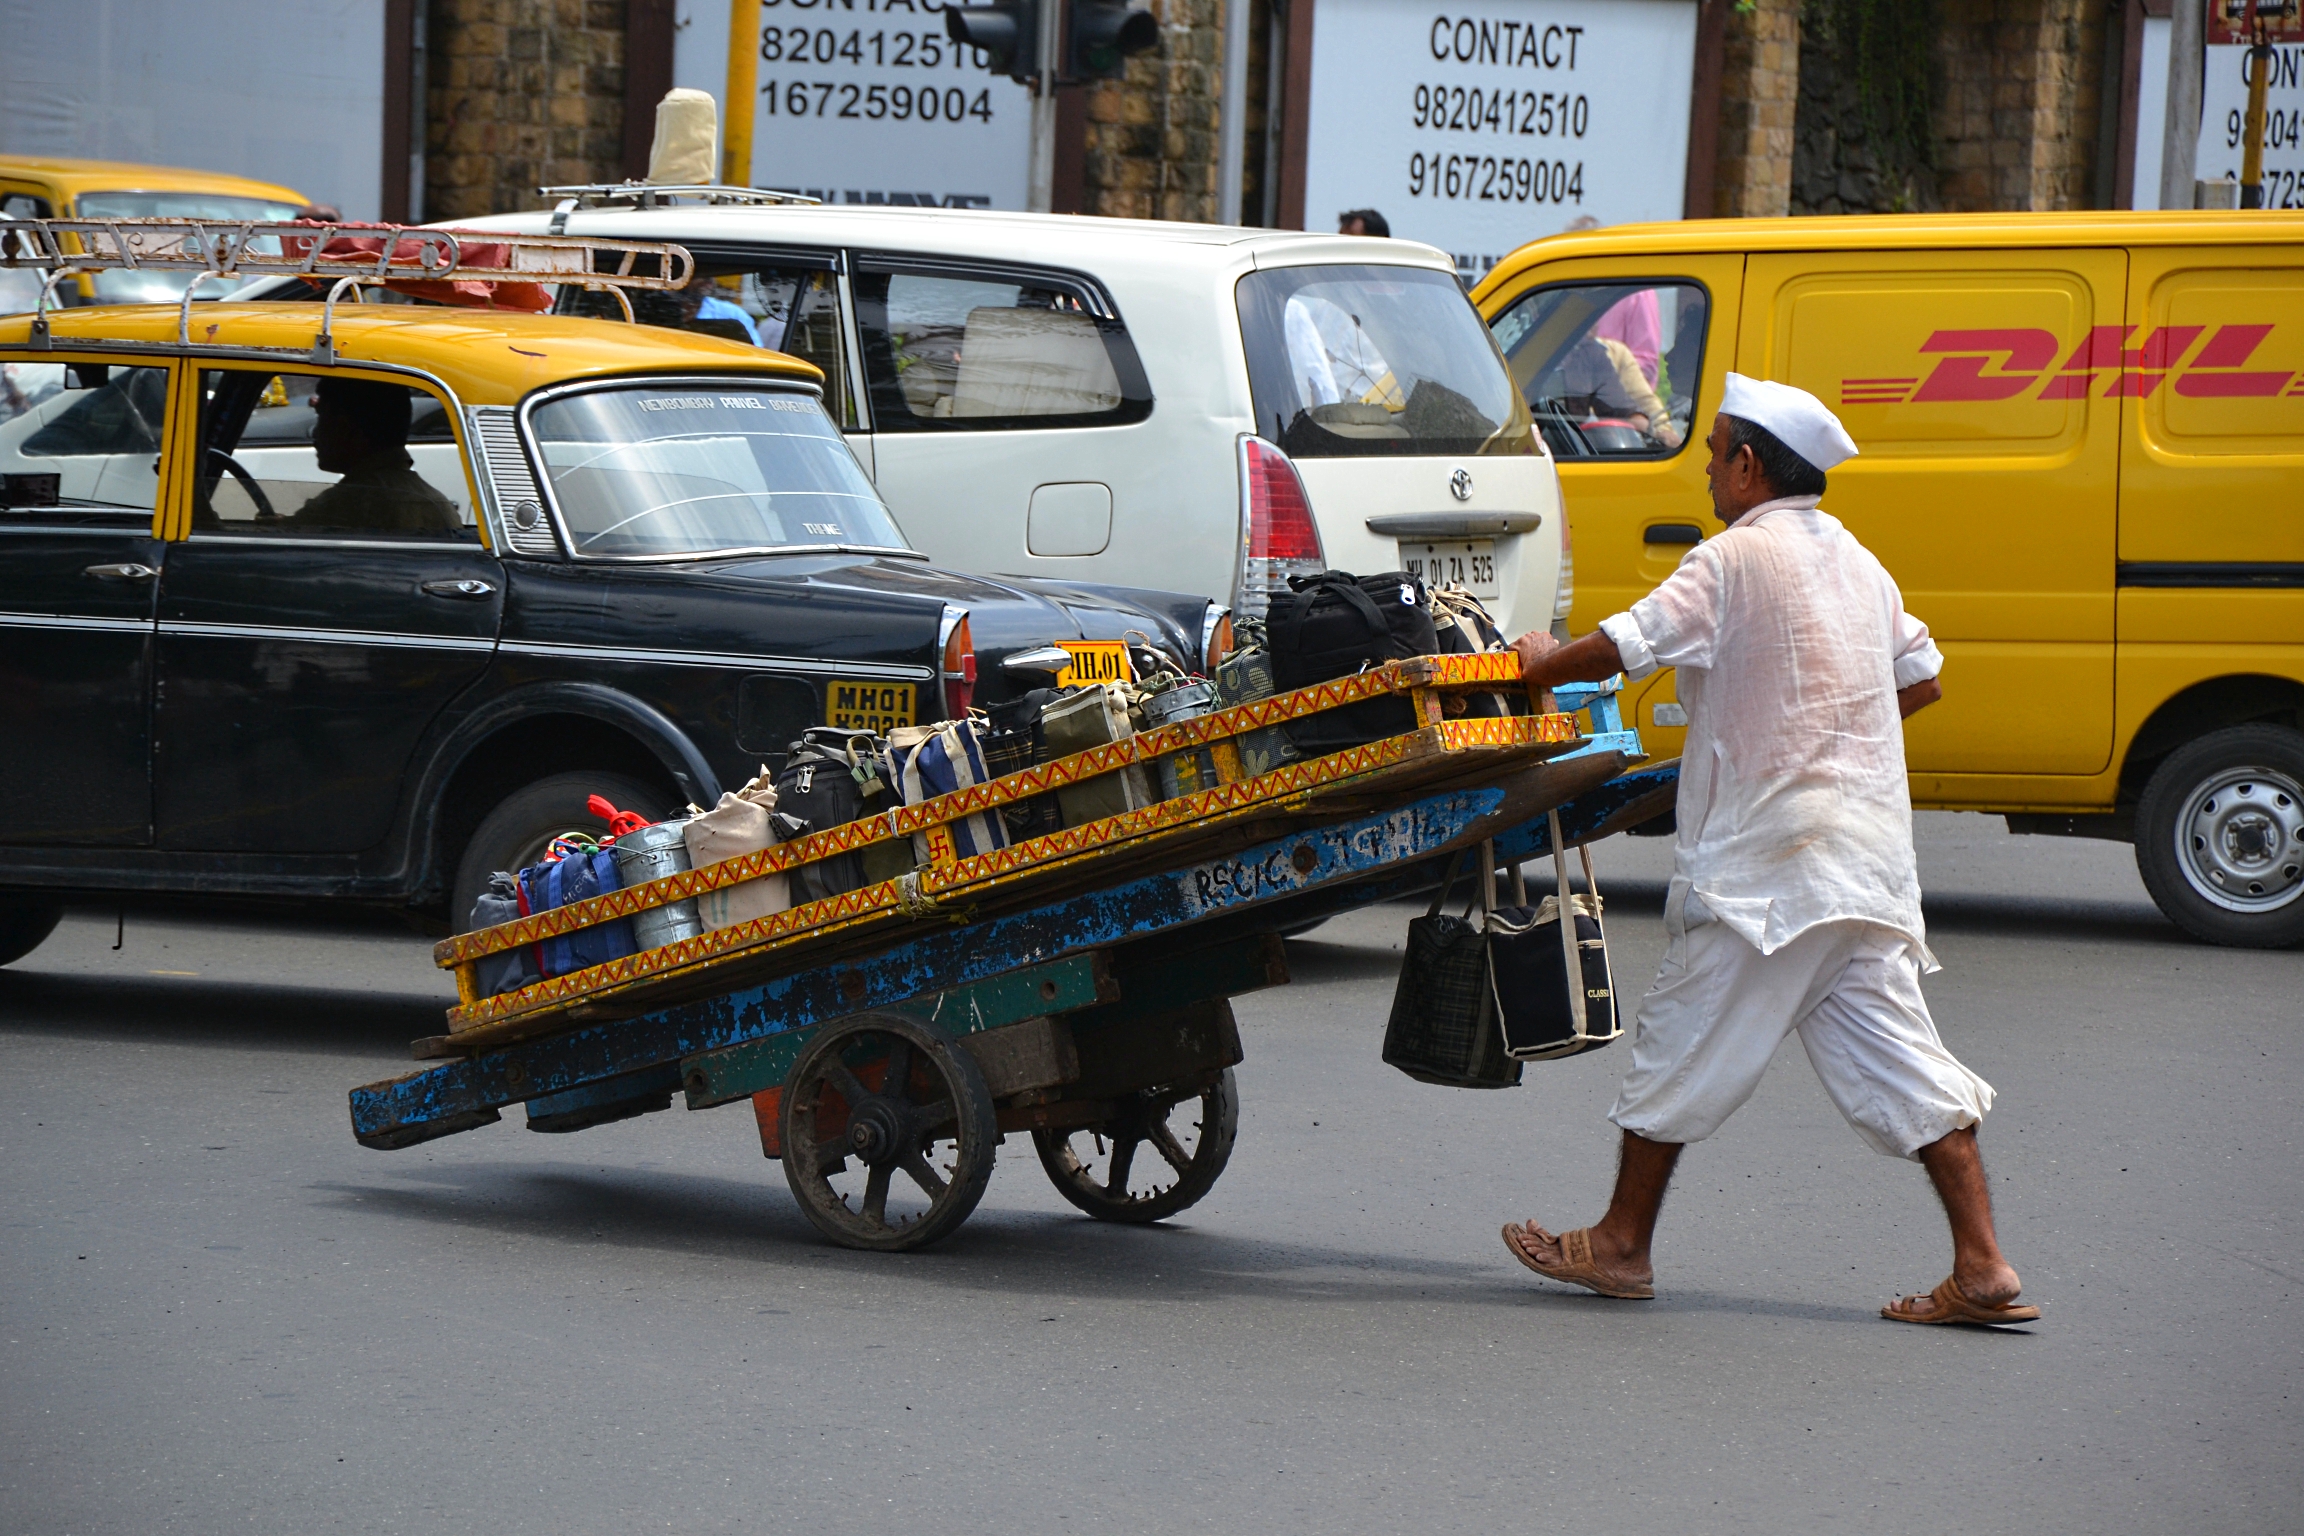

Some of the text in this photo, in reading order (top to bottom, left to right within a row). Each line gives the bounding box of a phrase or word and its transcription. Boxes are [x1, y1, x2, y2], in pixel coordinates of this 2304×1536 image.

[1431, 15, 1584, 70] CONTACT
[1413, 84, 1588, 138] 9820412510
[1409, 152, 1583, 204] 9167259004
[1910, 324, 2296, 402] DHL
[1472, 556, 1493, 583] 525
[837, 687, 908, 712] MH01
